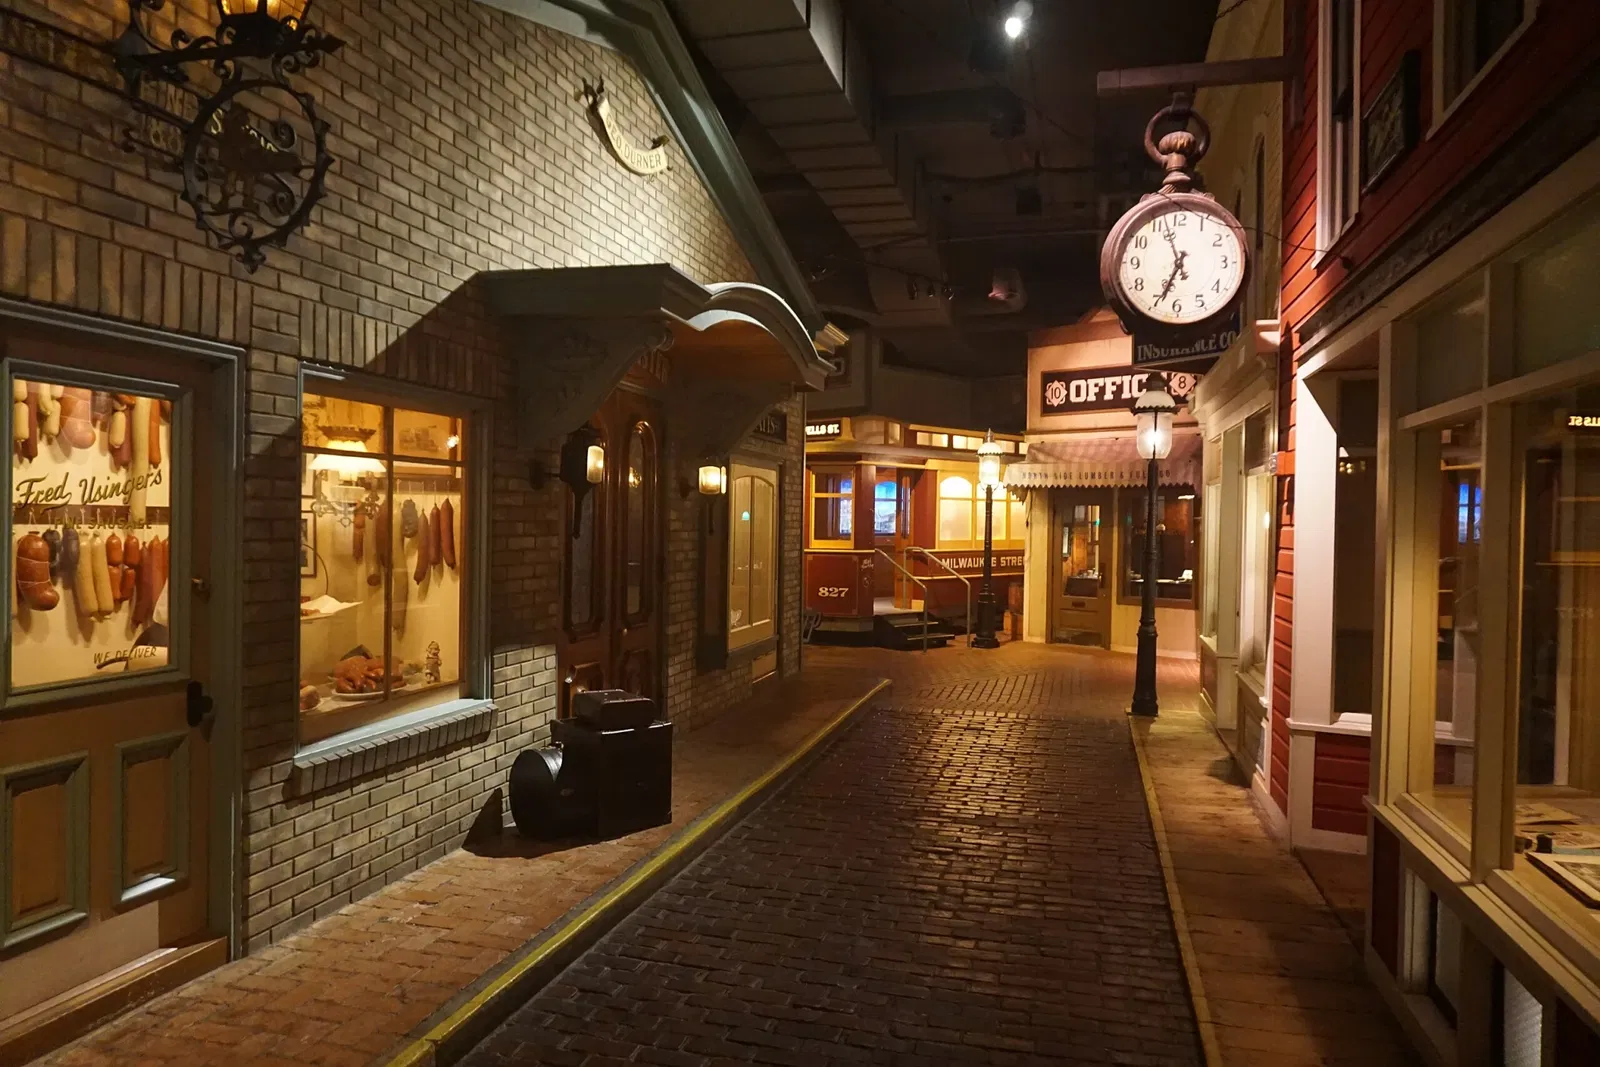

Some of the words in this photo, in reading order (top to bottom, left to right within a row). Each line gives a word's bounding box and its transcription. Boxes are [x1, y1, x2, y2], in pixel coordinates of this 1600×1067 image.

[624, 144, 661, 169] DURNER
[1152, 219, 1162, 233] 11
[1173, 213, 1187, 227] 12
[1134, 235, 1148, 250] 10
[1212, 233, 1223, 247] 2
[1130, 256, 1140, 270] 9
[1220, 254, 1228, 269] 3
[1134, 277, 1144, 292] 8
[1210, 278, 1220, 294] 4
[1152, 294, 1162, 308] 7
[1172, 299, 1182, 313] 6
[1195, 294, 1205, 308] 5
[1070, 372, 1168, 403] OFFIC
[1178, 376, 1186, 389] 8
[1050, 387, 1062, 400] 10
[1054, 472, 1072, 480] SIDE
[1078, 471, 1114, 480] LUMBER
[1130, 470, 1146, 480] FUE
[16, 472, 72, 515] Fred
[941, 556, 997, 570] MILWAUKE
[1000, 556, 1025, 567] STRE
[818, 586, 849, 598] 827
[94, 652, 110, 664] WE
[115, 646, 157, 660] DELIVER
